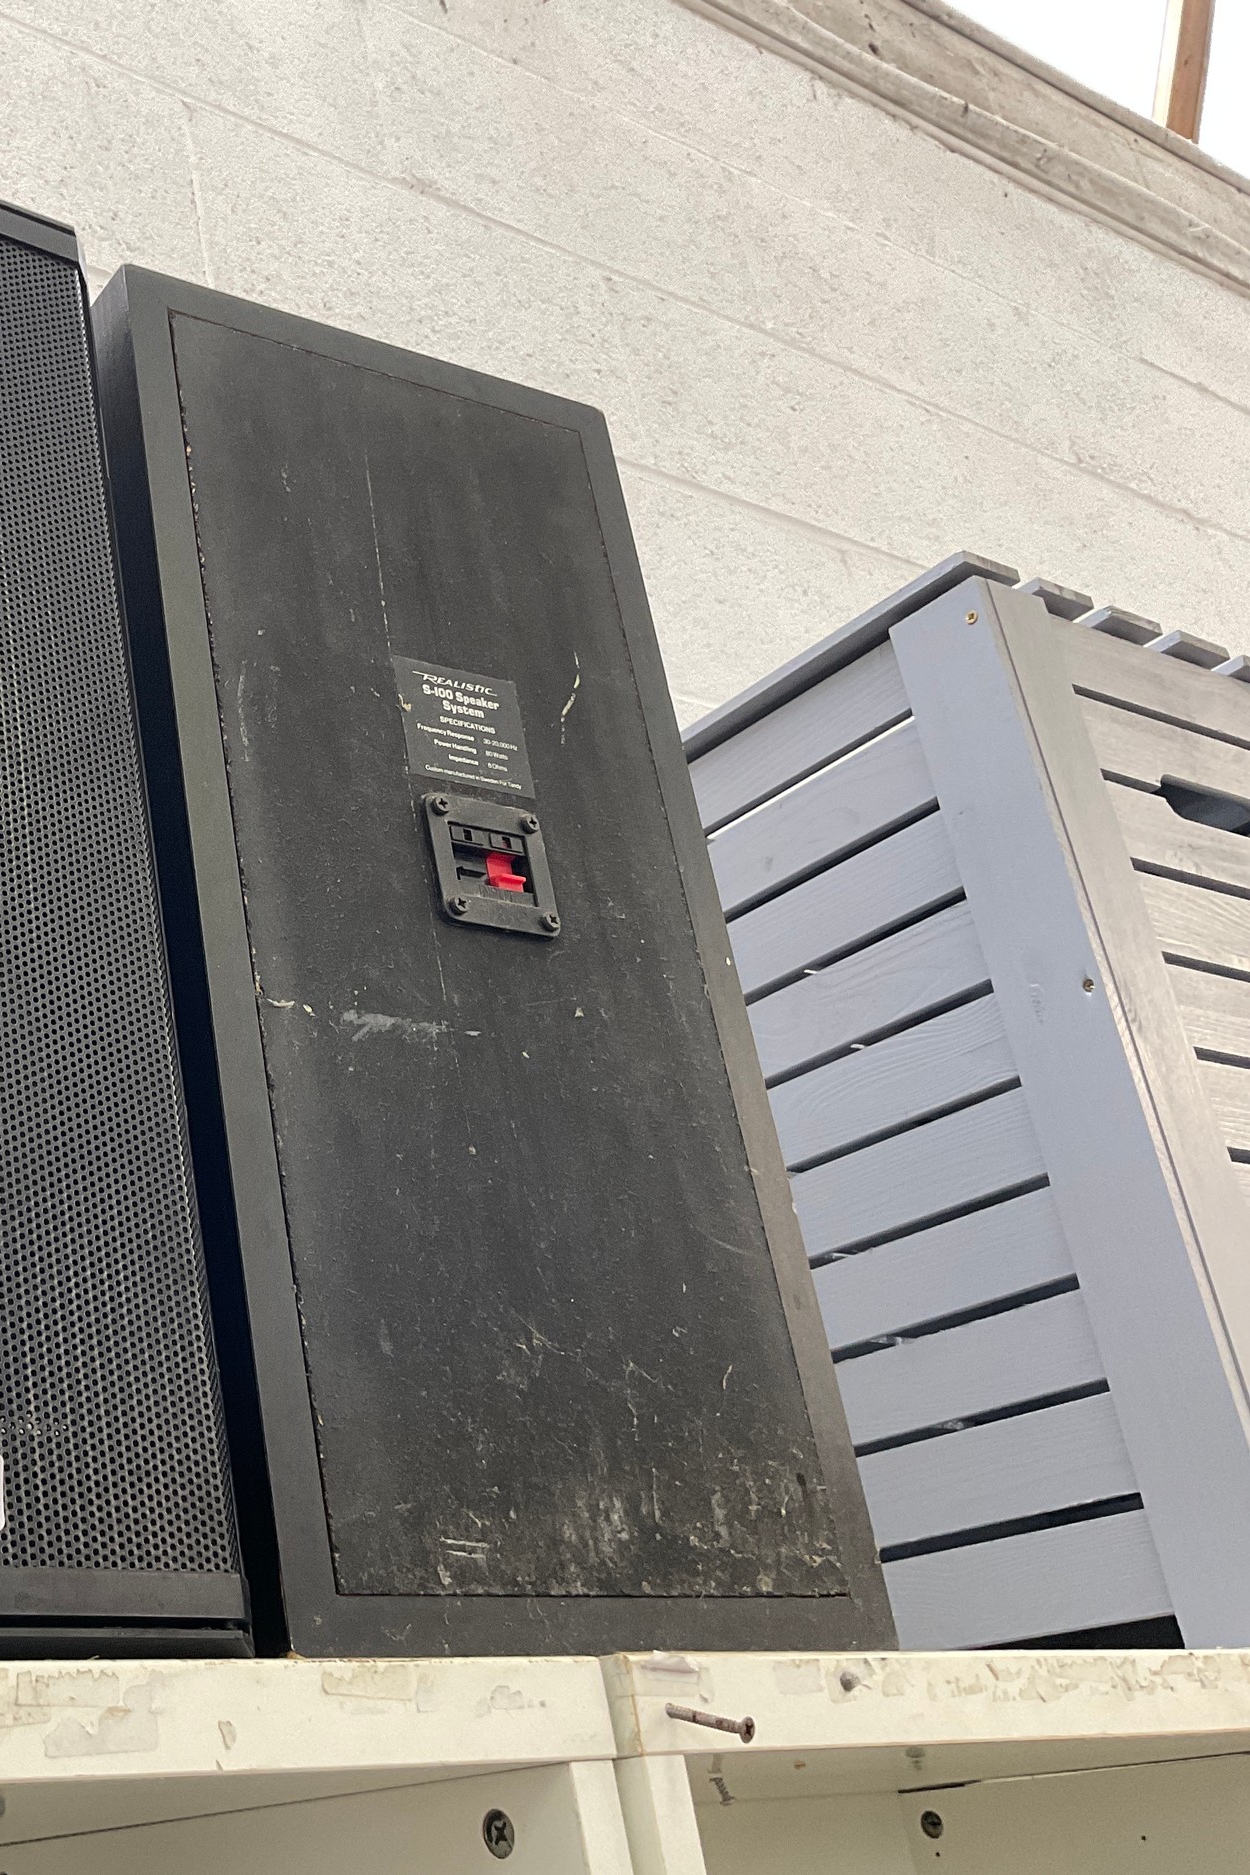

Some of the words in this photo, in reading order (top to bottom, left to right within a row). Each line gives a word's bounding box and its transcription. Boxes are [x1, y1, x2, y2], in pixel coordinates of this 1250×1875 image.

[422, 684, 453, 700] S-100
[455, 691, 500, 710] Speaker
[442, 700, 485, 719] System
[417, 722, 447, 736] Frequency
[447, 729, 475, 742] Response
[439, 716, 496, 734] SPECIFICATIONS
[434, 738, 452, 748] Power
[452, 743, 478, 755] Handling
[448, 754, 479, 766] Impedance
[425, 764, 444, 774] Custom
[444, 769, 476, 780] manufactured
